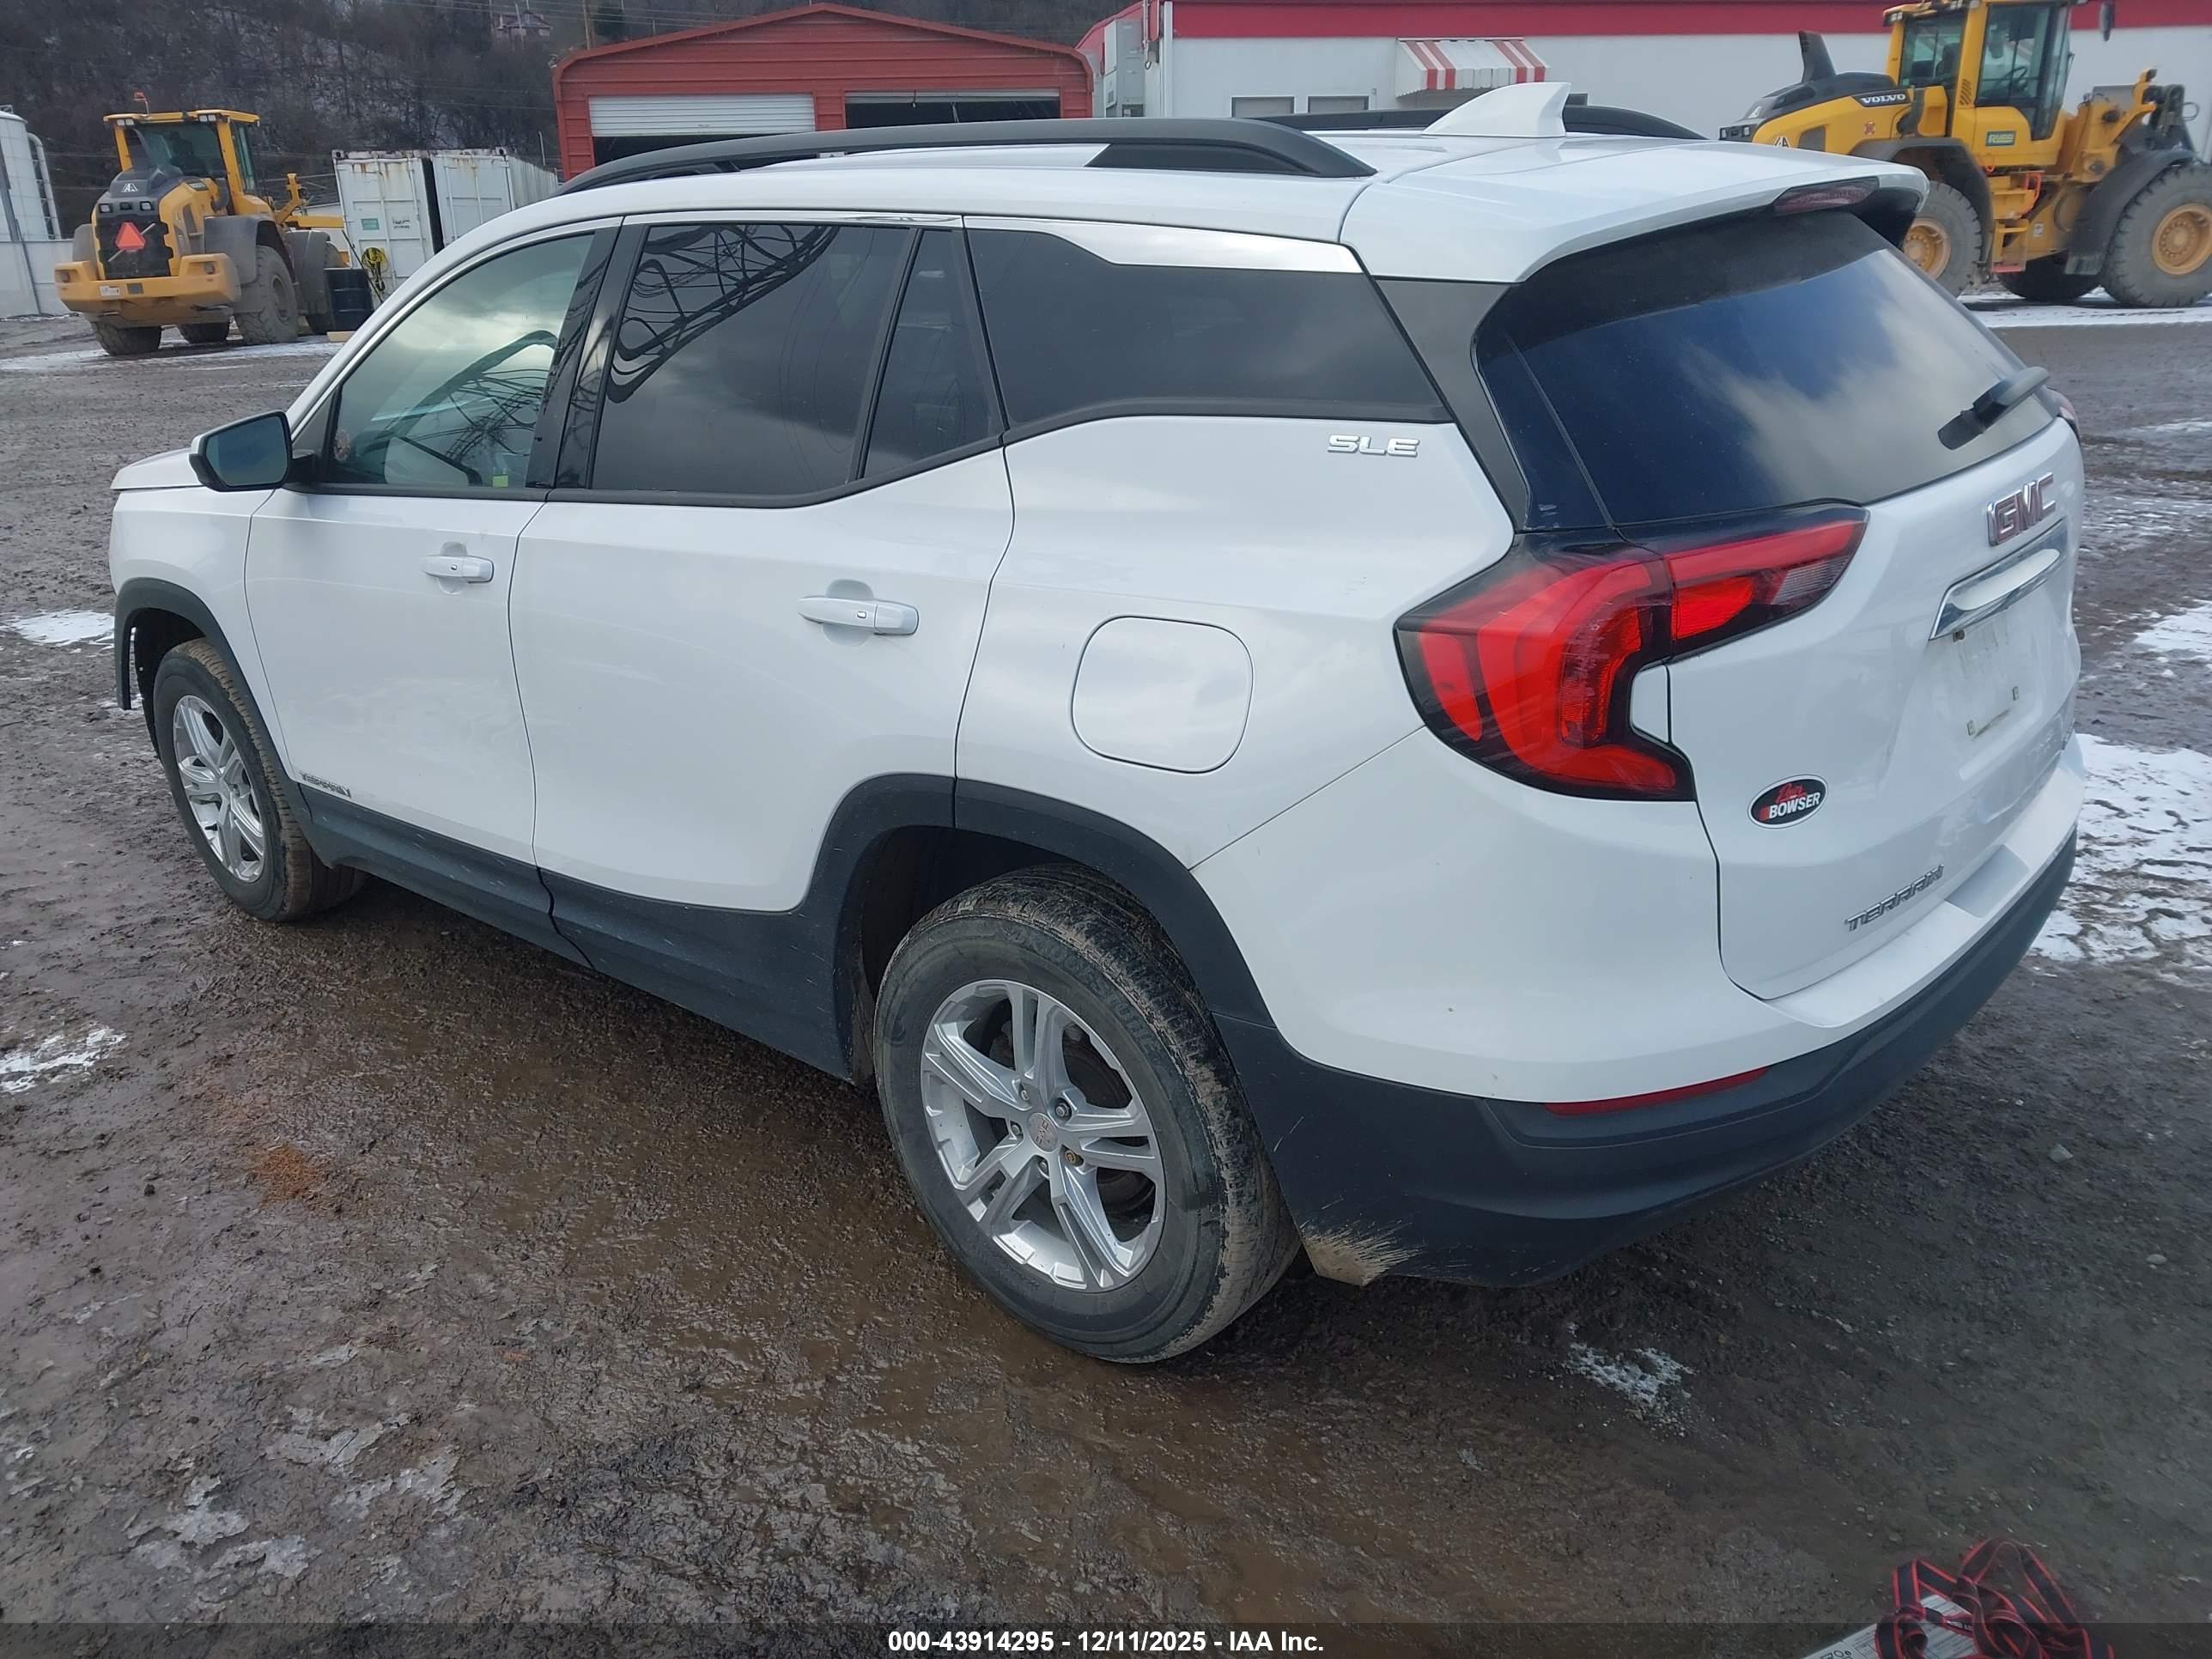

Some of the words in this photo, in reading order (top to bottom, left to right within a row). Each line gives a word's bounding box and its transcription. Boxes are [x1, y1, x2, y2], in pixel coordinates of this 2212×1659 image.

[1860, 94, 1906, 104] VOLVO
[1327, 434, 1420, 458] SLE
[1987, 471, 2056, 546] GMC
[1769, 792, 1821, 819] BOWSER
[1844, 864, 1944, 932] TERRAIN
